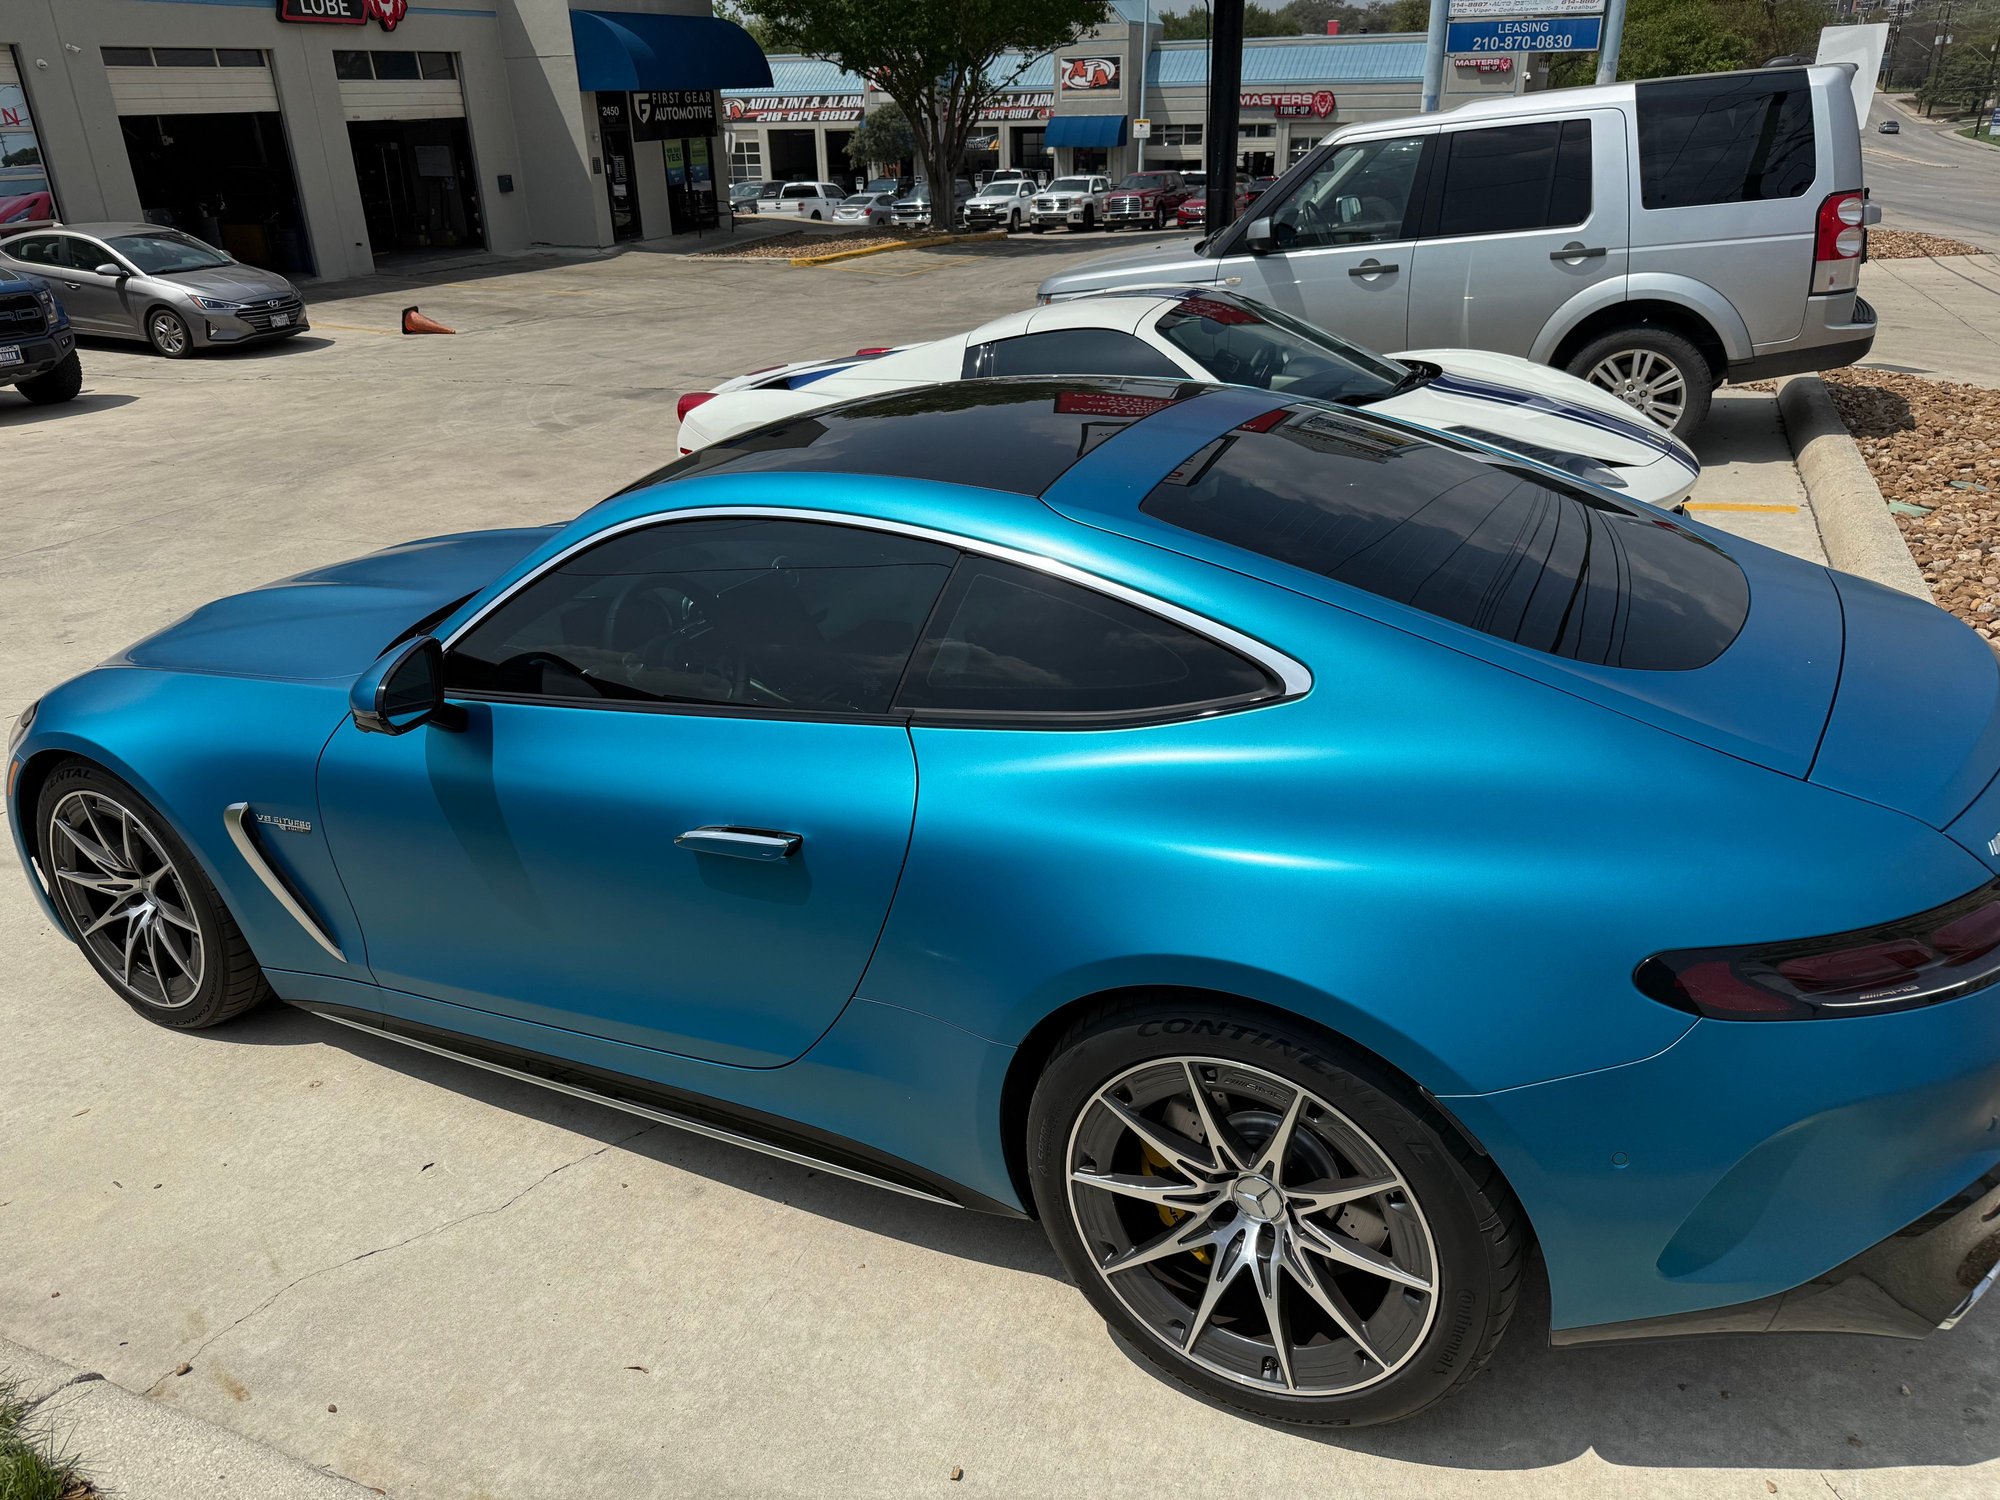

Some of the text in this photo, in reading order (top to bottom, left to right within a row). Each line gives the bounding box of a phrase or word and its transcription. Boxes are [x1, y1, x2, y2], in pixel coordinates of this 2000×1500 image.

[1498, 22, 1549, 33] LEASING
[1472, 35, 1572, 50] 210-870-0830
[1069, 60, 1109, 88] ATA
[652, 91, 711, 105] FIRST GEAR
[747, 98, 777, 110] AUTO
[781, 97, 806, 110] TINT
[823, 95, 865, 108] ALARM
[1016, 93, 1055, 108] ALARM
[1240, 94, 1313, 106] MASTERS
[602, 106, 619, 116] 2450
[654, 106, 713, 121] AUTOMOTIVE
[667, 153, 683, 163] YES!
[256, 813, 272, 822] V8
[1880, 985, 1920, 997] AMG
